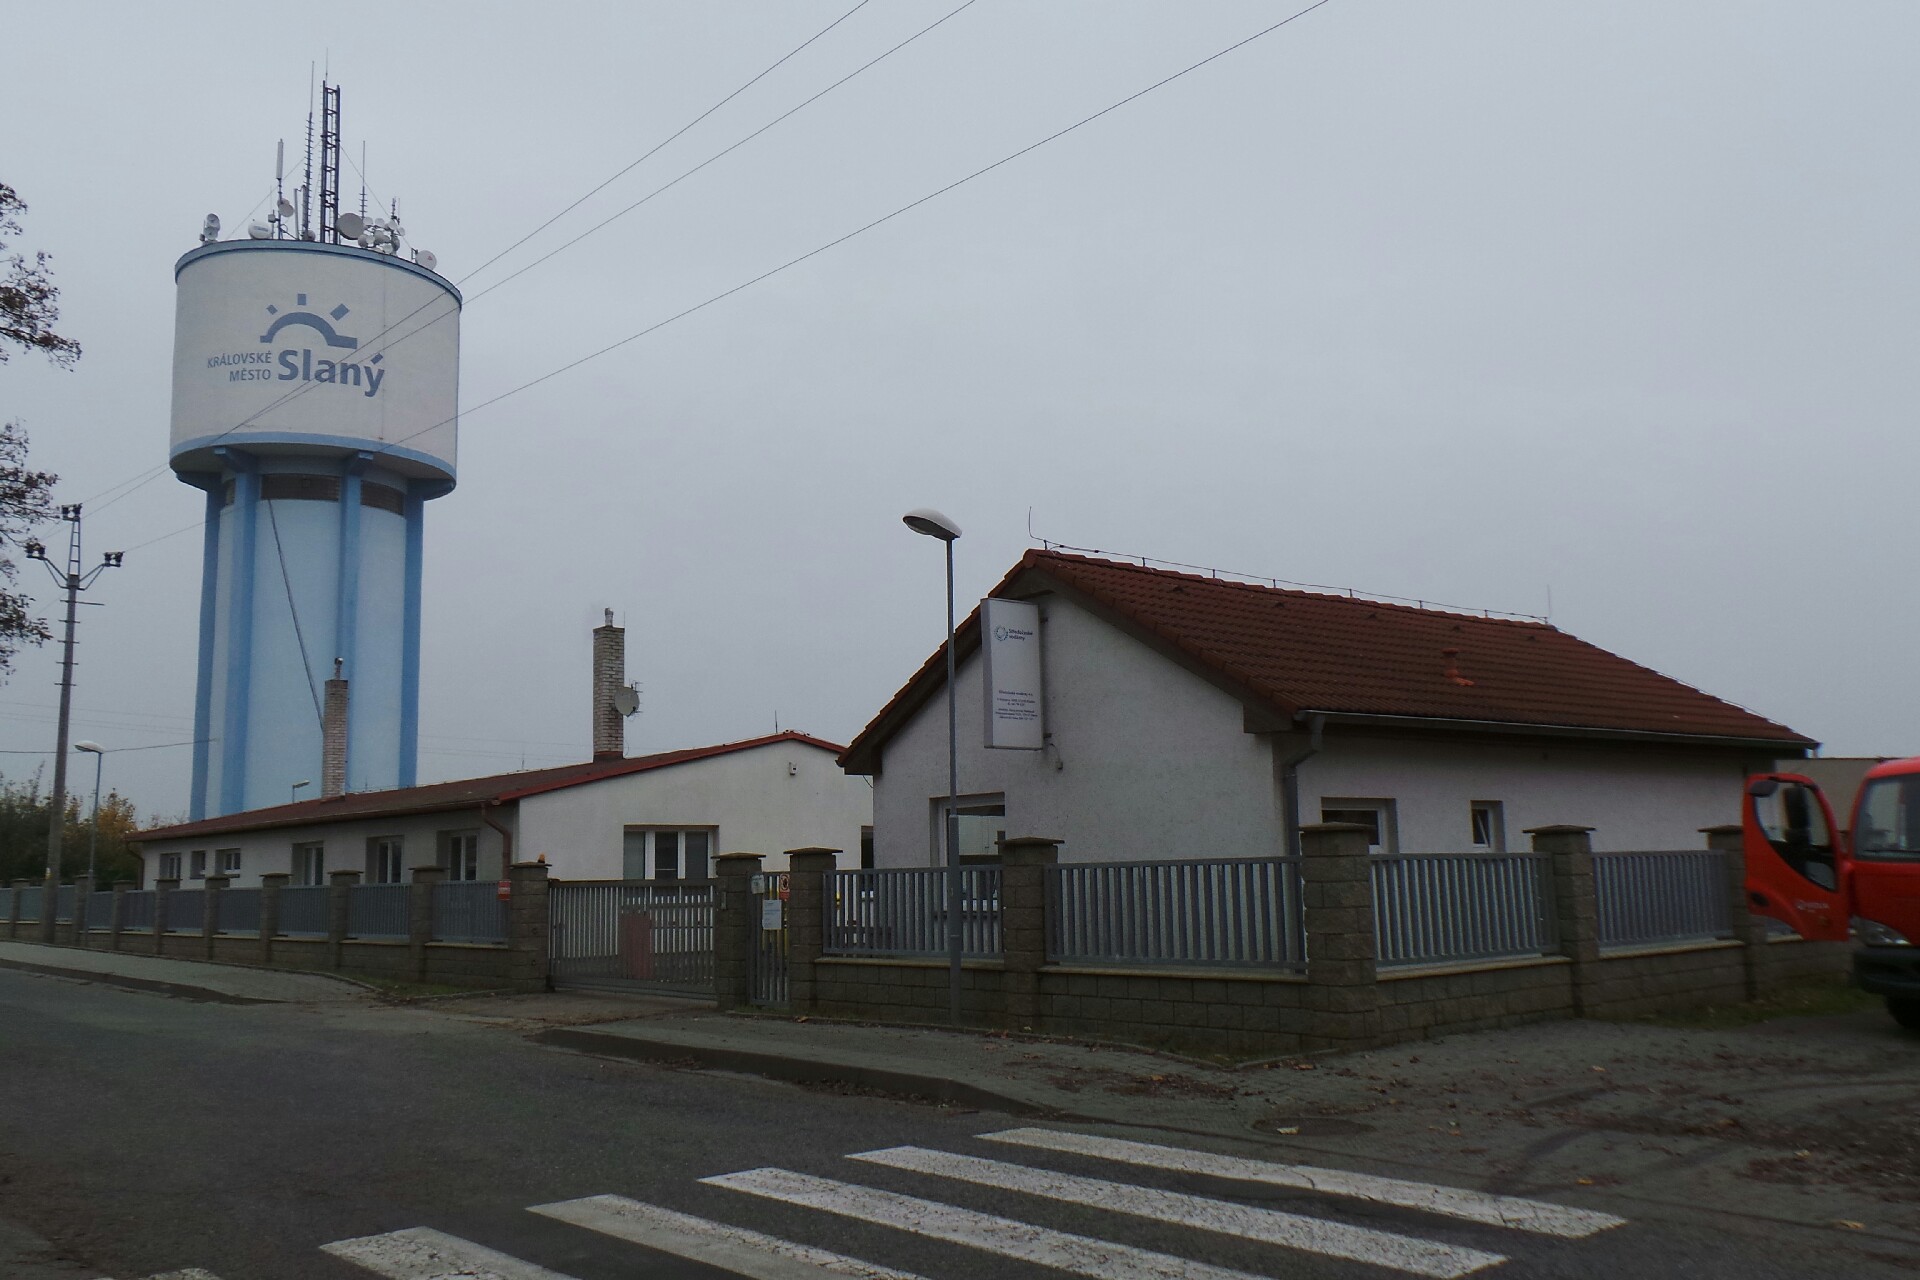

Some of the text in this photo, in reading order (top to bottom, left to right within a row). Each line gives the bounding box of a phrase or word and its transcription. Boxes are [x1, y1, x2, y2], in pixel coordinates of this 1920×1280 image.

[207, 350, 272, 368] KRÁLOVSKÉ
[229, 367, 271, 382] MĚSTO
[278, 349, 385, 397] Slaný
